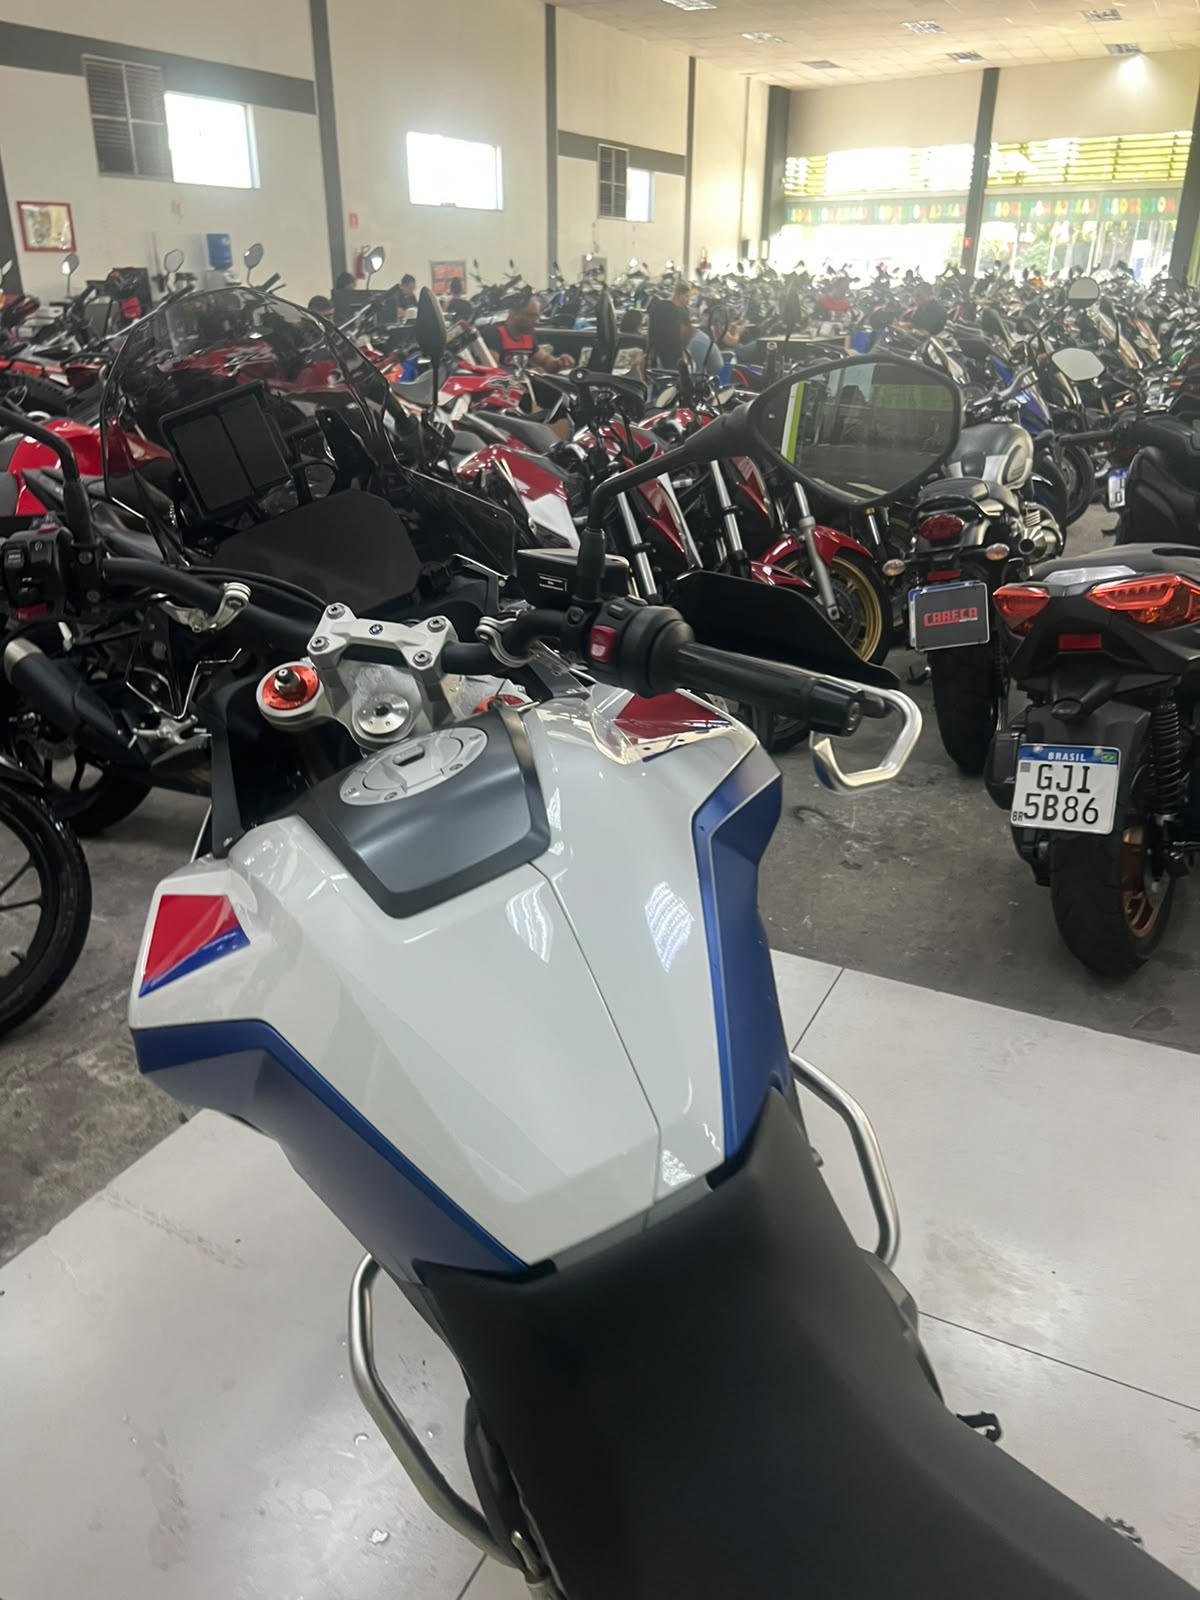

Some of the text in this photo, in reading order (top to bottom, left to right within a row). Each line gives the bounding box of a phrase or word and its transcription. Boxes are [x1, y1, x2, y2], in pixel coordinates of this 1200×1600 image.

[923, 607, 978, 627] CARECA
[1048, 752, 1087, 761] BRASIL
[1036, 763, 1091, 793] GJI
[1012, 811, 1023, 822] BR
[1023, 793, 1099, 825] 5B86
